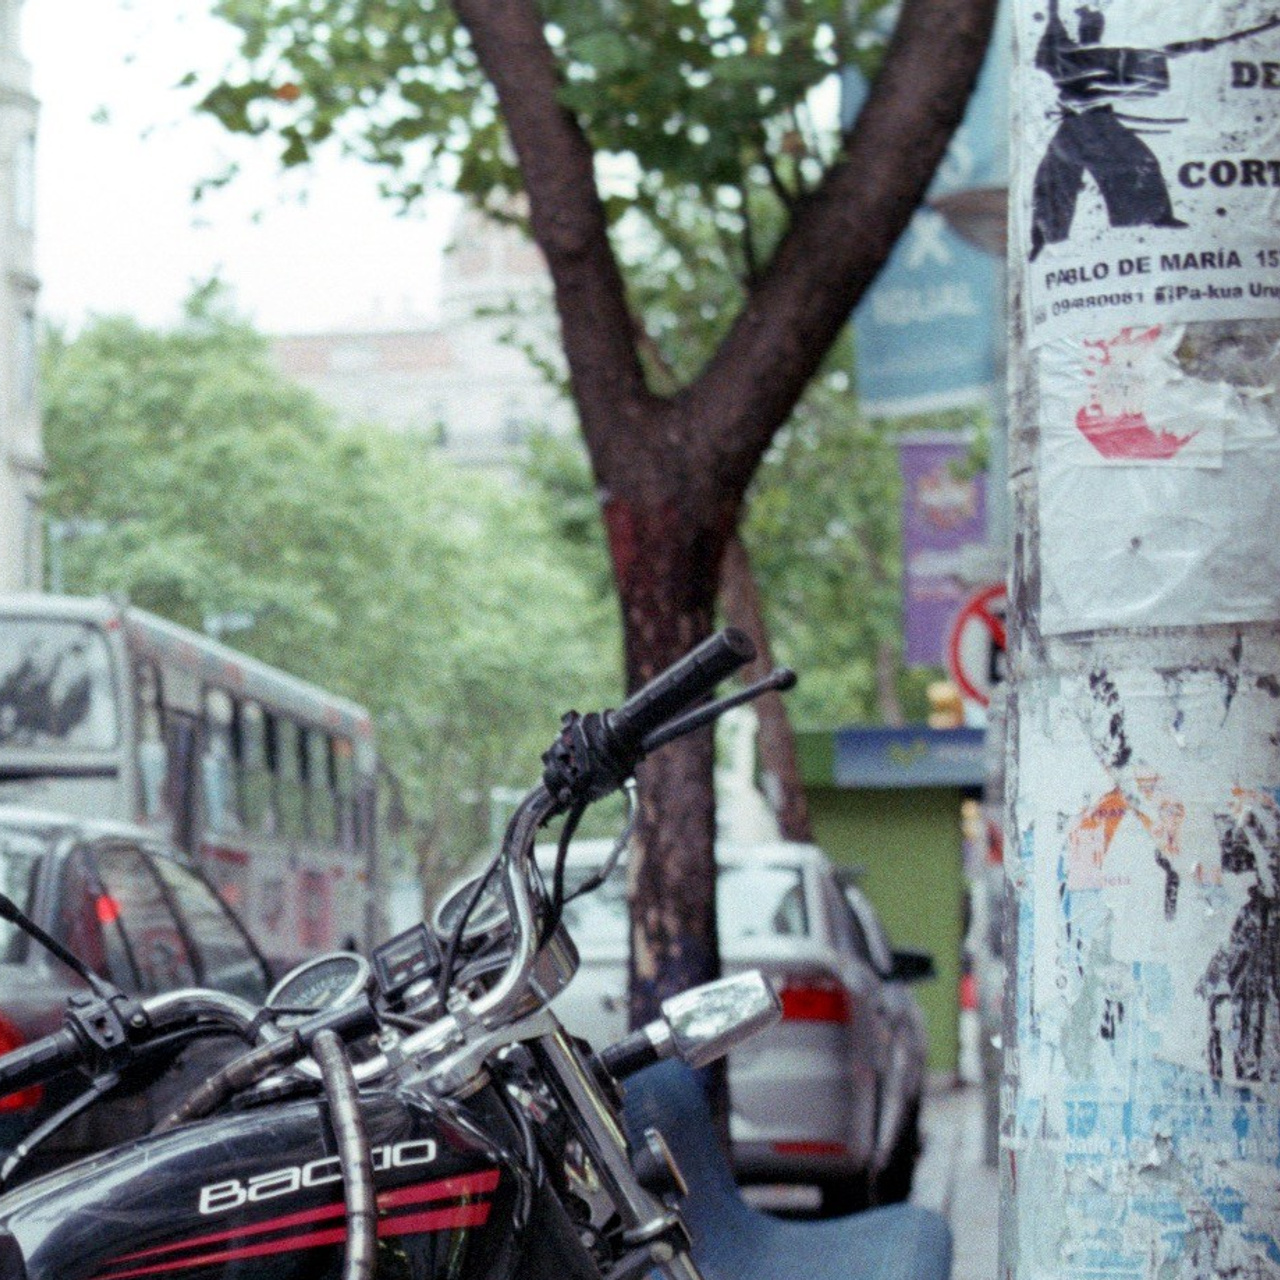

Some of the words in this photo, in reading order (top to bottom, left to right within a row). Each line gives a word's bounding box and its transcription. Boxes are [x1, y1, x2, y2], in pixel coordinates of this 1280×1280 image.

[1045, 262, 1109, 290] PABLO
[1118, 256, 1151, 276] DE
[1160, 247, 1242, 271] MARÍA
[1255, 249, 1280, 268] 15
[198, 1139, 436, 1215] Bacio
